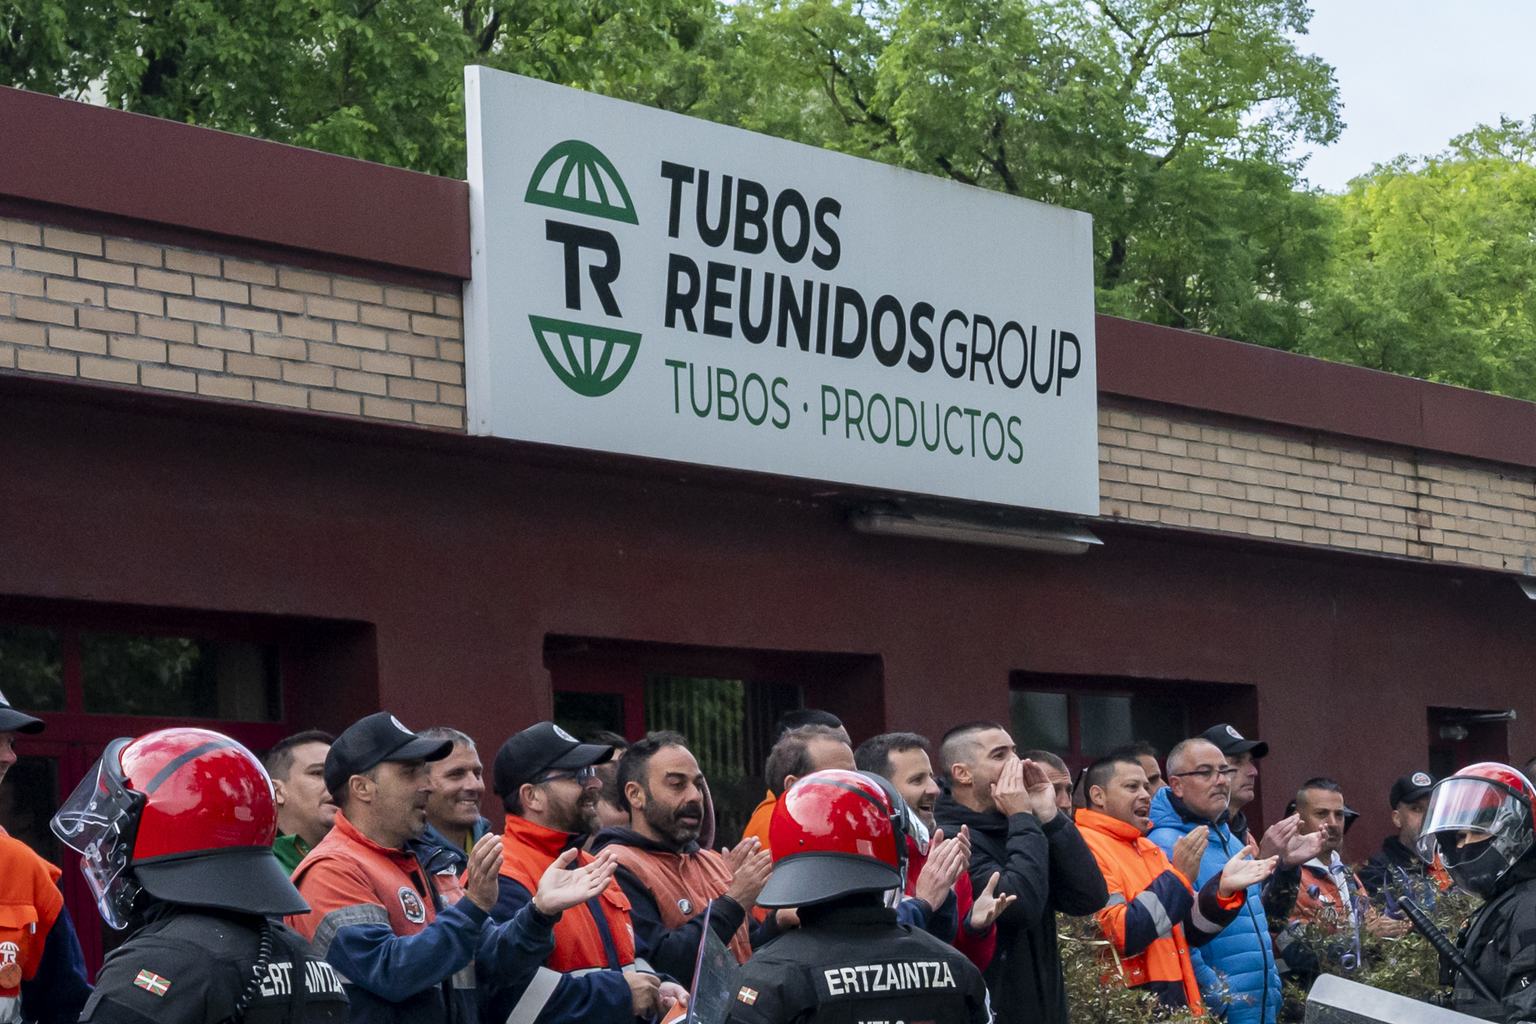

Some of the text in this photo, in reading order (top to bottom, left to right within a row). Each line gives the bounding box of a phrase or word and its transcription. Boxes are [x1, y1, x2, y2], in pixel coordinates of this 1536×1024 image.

[660, 159, 843, 271] TUBOS
[545, 219, 623, 318] TR
[664, 358, 1024, 465] TUBOS PRODUCTOS
[824, 961, 956, 996] ERTZAINTZA
